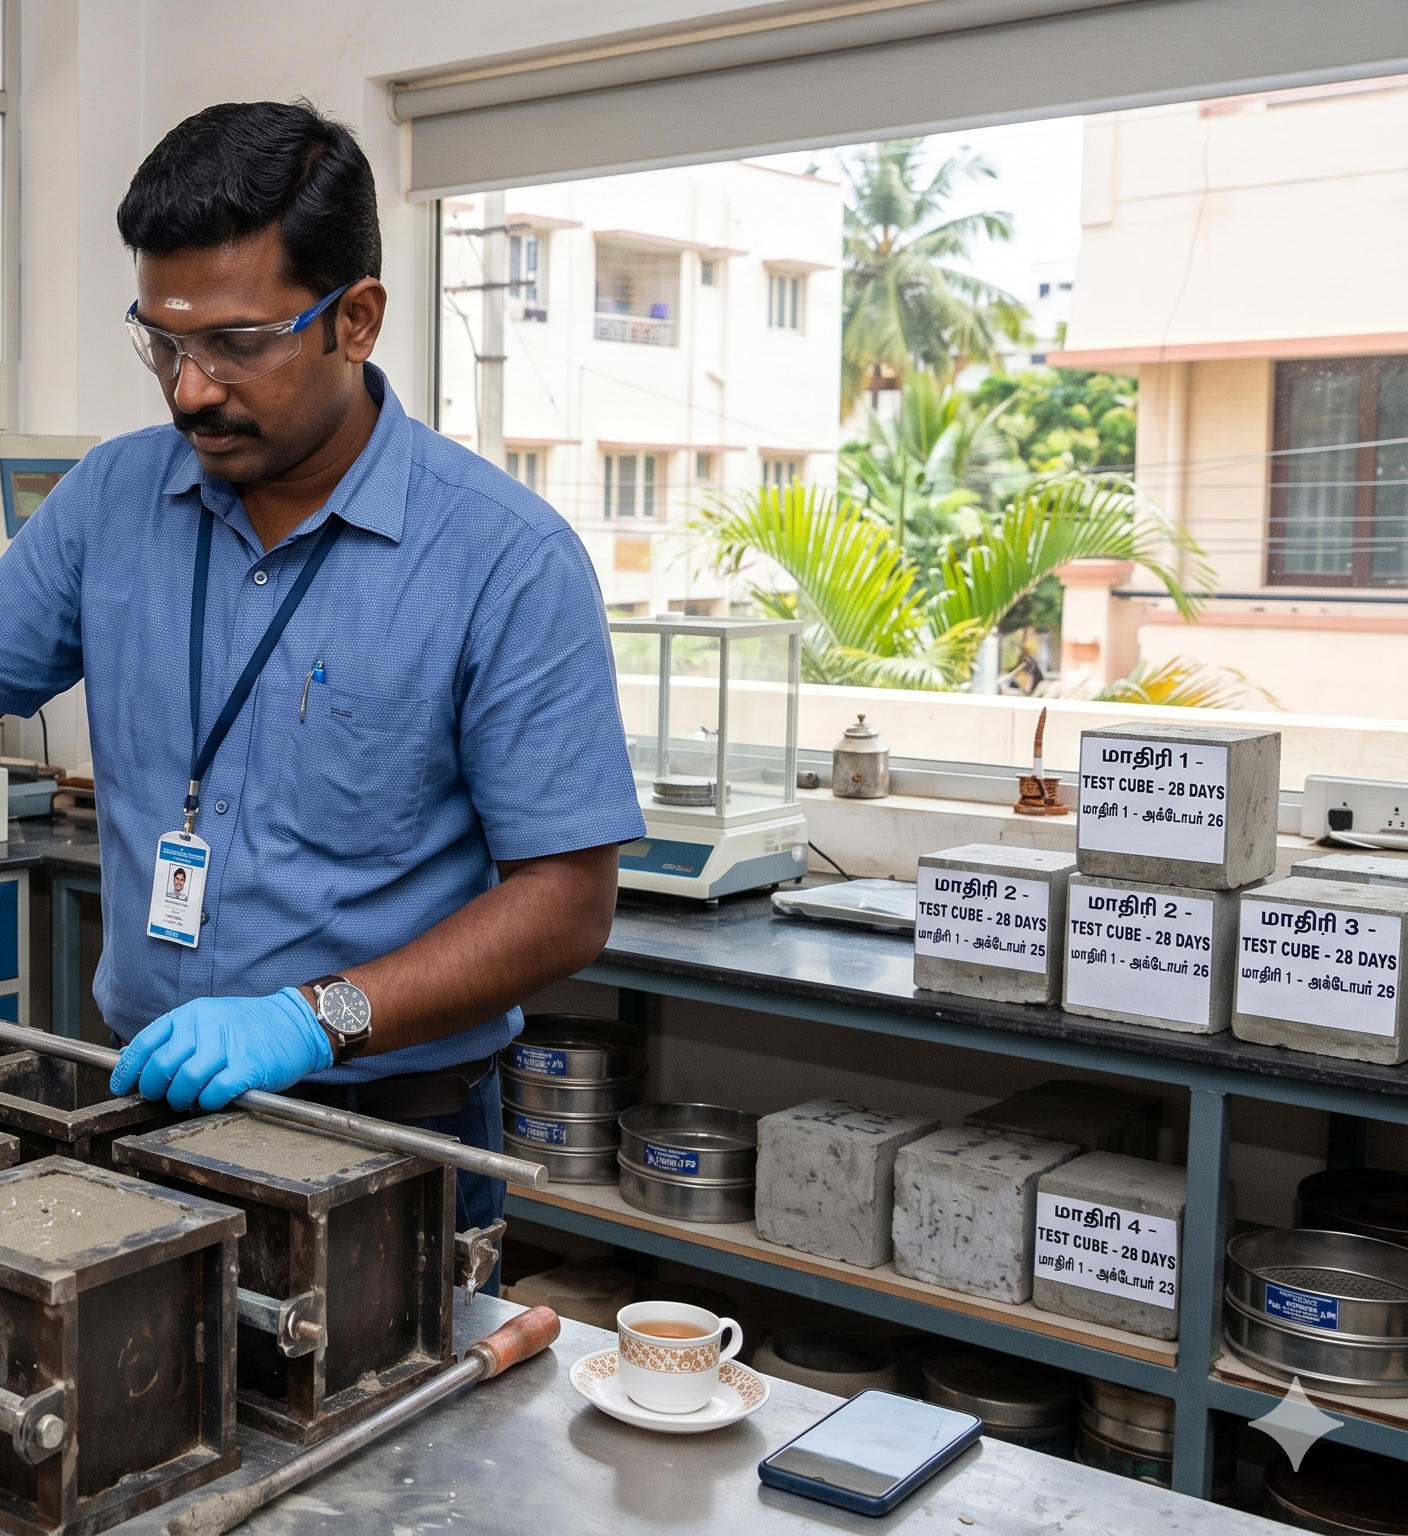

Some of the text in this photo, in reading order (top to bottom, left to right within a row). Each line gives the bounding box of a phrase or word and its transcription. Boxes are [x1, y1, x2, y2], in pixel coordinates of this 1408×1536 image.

[1102, 747, 1172, 770] மாதிரி
[1180, 753, 1187, 768] 1
[1082, 775, 1114, 790] TEST
[1119, 778, 1154, 793] CUBE
[1168, 782, 1184, 796] 28
[1190, 783, 1225, 800] DAYS
[1122, 806, 1127, 818] 1
[1208, 814, 1223, 827] 26
[935, 878, 997, 899] மாதிரி
[1004, 886, 1016, 900] 2
[919, 902, 947, 917] TEST
[952, 906, 983, 922] CUBE
[996, 912, 1010, 926] 28
[1015, 915, 1046, 931] DAYS
[1088, 895, 1156, 918] மாதிரி
[1164, 903, 1177, 918] 2
[1262, 910, 1336, 935] மாதிரி
[1345, 919, 1358, 935] 3
[956, 934, 959, 943] 1
[1031, 944, 1045, 956] 25
[1071, 920, 1102, 936] TEST
[1107, 924, 1141, 941] CUBE
[1156, 931, 1171, 946] 28
[1176, 934, 1210, 951] DAYS
[1111, 953, 1115, 964] 1
[1193, 964, 1209, 977] 26
[1243, 937, 1276, 954] TEST
[1282, 941, 1320, 960] CUBE
[1336, 949, 1353, 964] 28
[1358, 952, 1396, 970] DAYS
[1286, 972, 1291, 984] 1
[1055, 1205, 1120, 1230] மாதிரி
[1128, 1220, 1141, 1234] 4
[1038, 1227, 1069, 1245] TEST
[1074, 1235, 1108, 1254] CUBE
[1122, 1246, 1137, 1261] 28
[1142, 1250, 1175, 1270] DAYS
[1079, 1262, 1083, 1273] 1
[1159, 1281, 1174, 1295] 23
